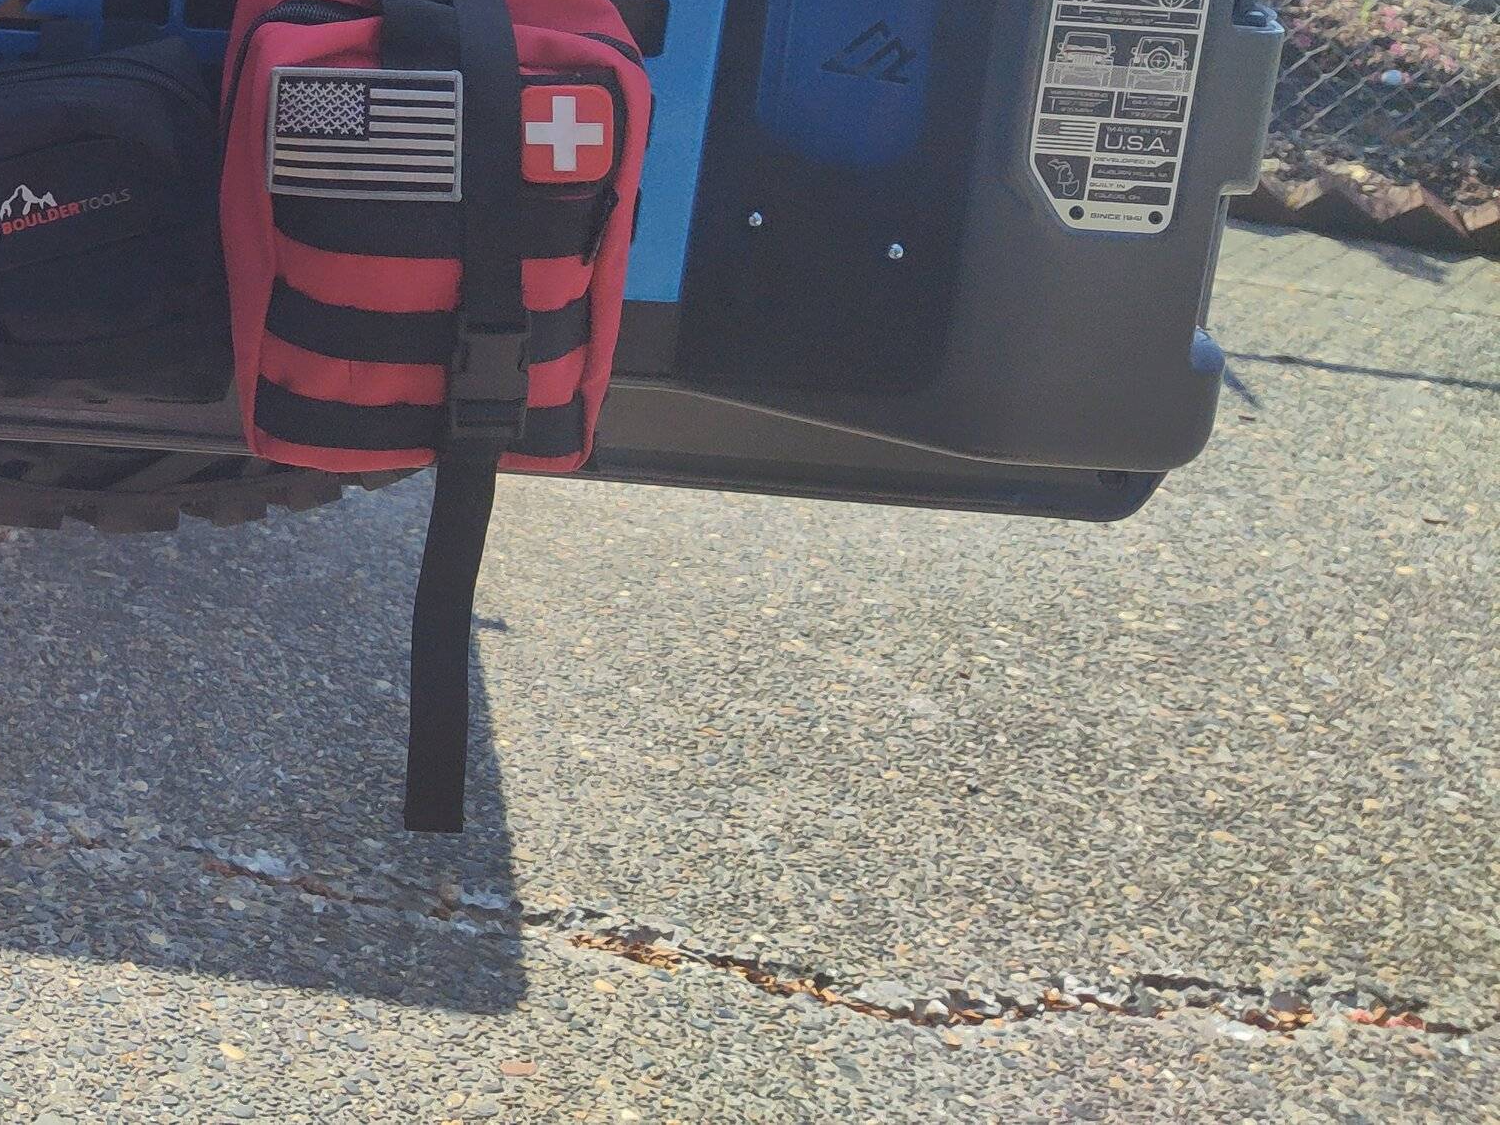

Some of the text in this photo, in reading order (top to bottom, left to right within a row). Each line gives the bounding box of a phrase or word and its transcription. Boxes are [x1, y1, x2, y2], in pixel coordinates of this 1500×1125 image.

[1106, 126, 1138, 134] MADE
[1104, 133, 1170, 153] U.S.A.
[1093, 156, 1147, 165] DEVELOPED
[1, 188, 131, 235] BOULDERTOOLS
[1090, 212, 1121, 221] SINCE
